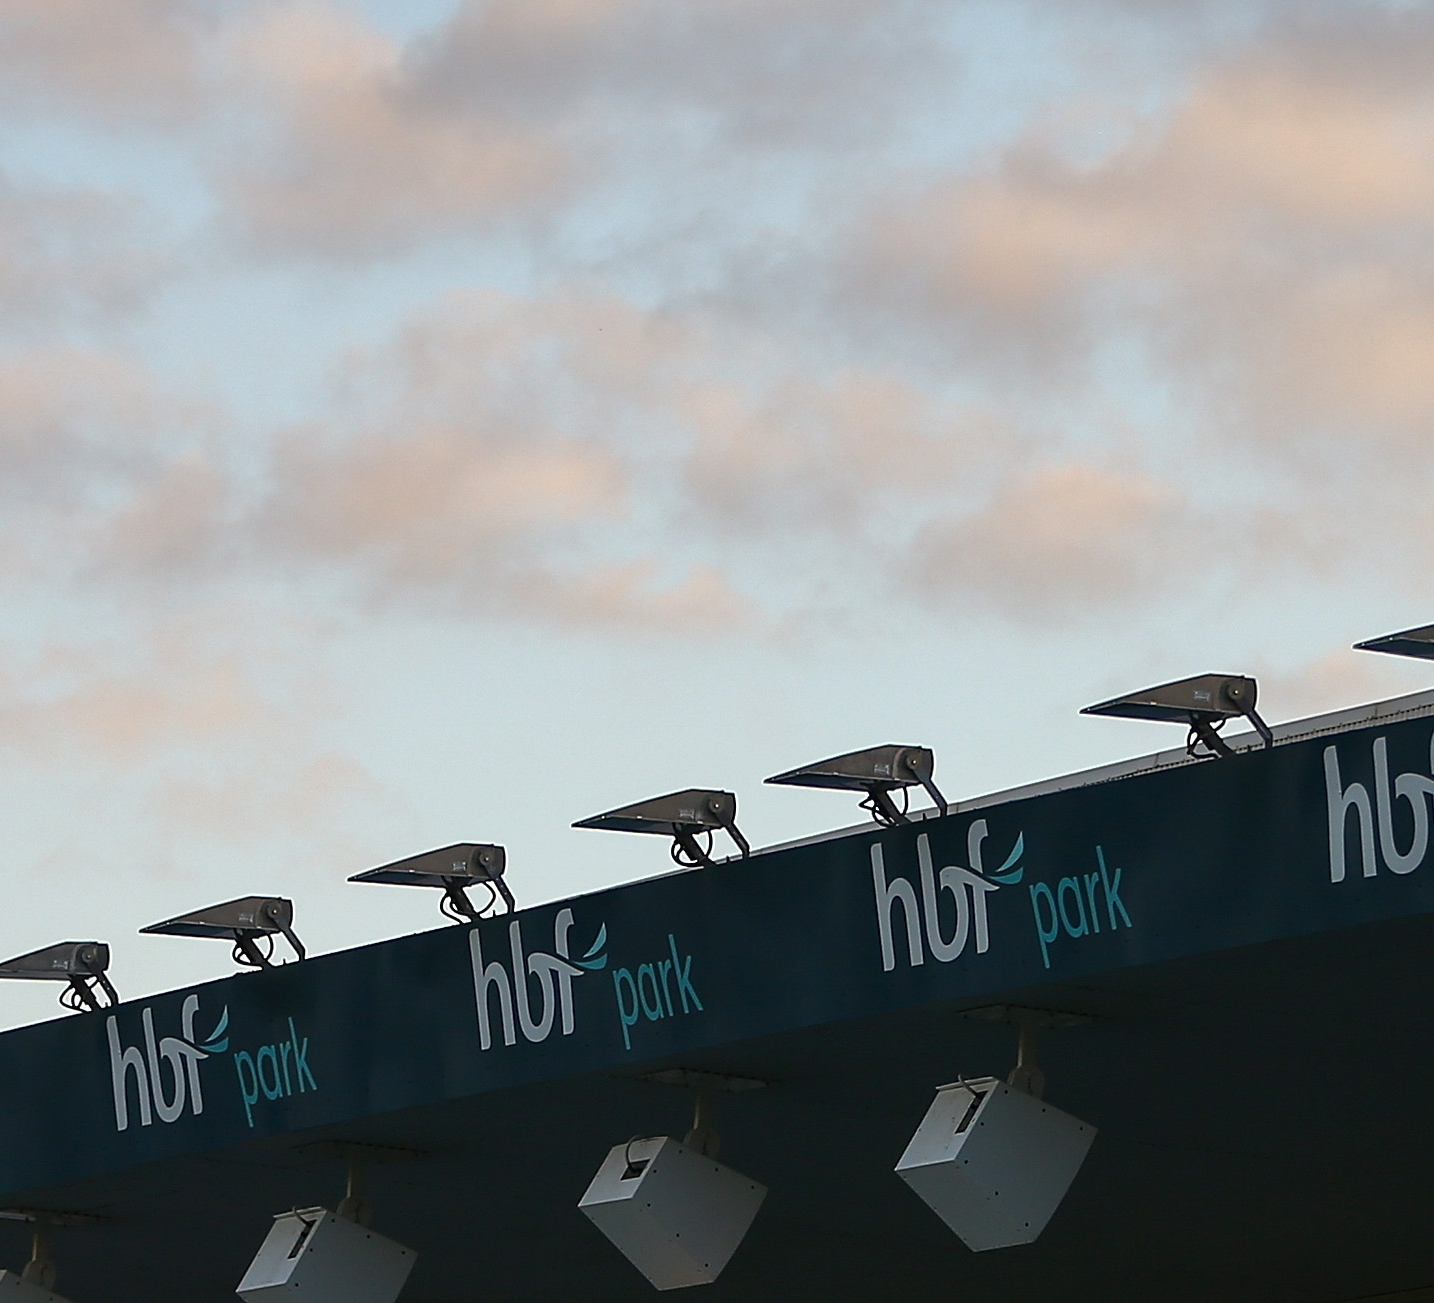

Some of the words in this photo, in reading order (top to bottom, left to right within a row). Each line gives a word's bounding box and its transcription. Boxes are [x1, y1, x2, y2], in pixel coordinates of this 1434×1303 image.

[871, 819, 999, 972] hbf
[1029, 846, 1132, 968] park
[468, 908, 587, 1051] hbf
[613, 934, 703, 1050] park
[107, 995, 211, 1132] hbf
[234, 1017, 317, 1127] park
